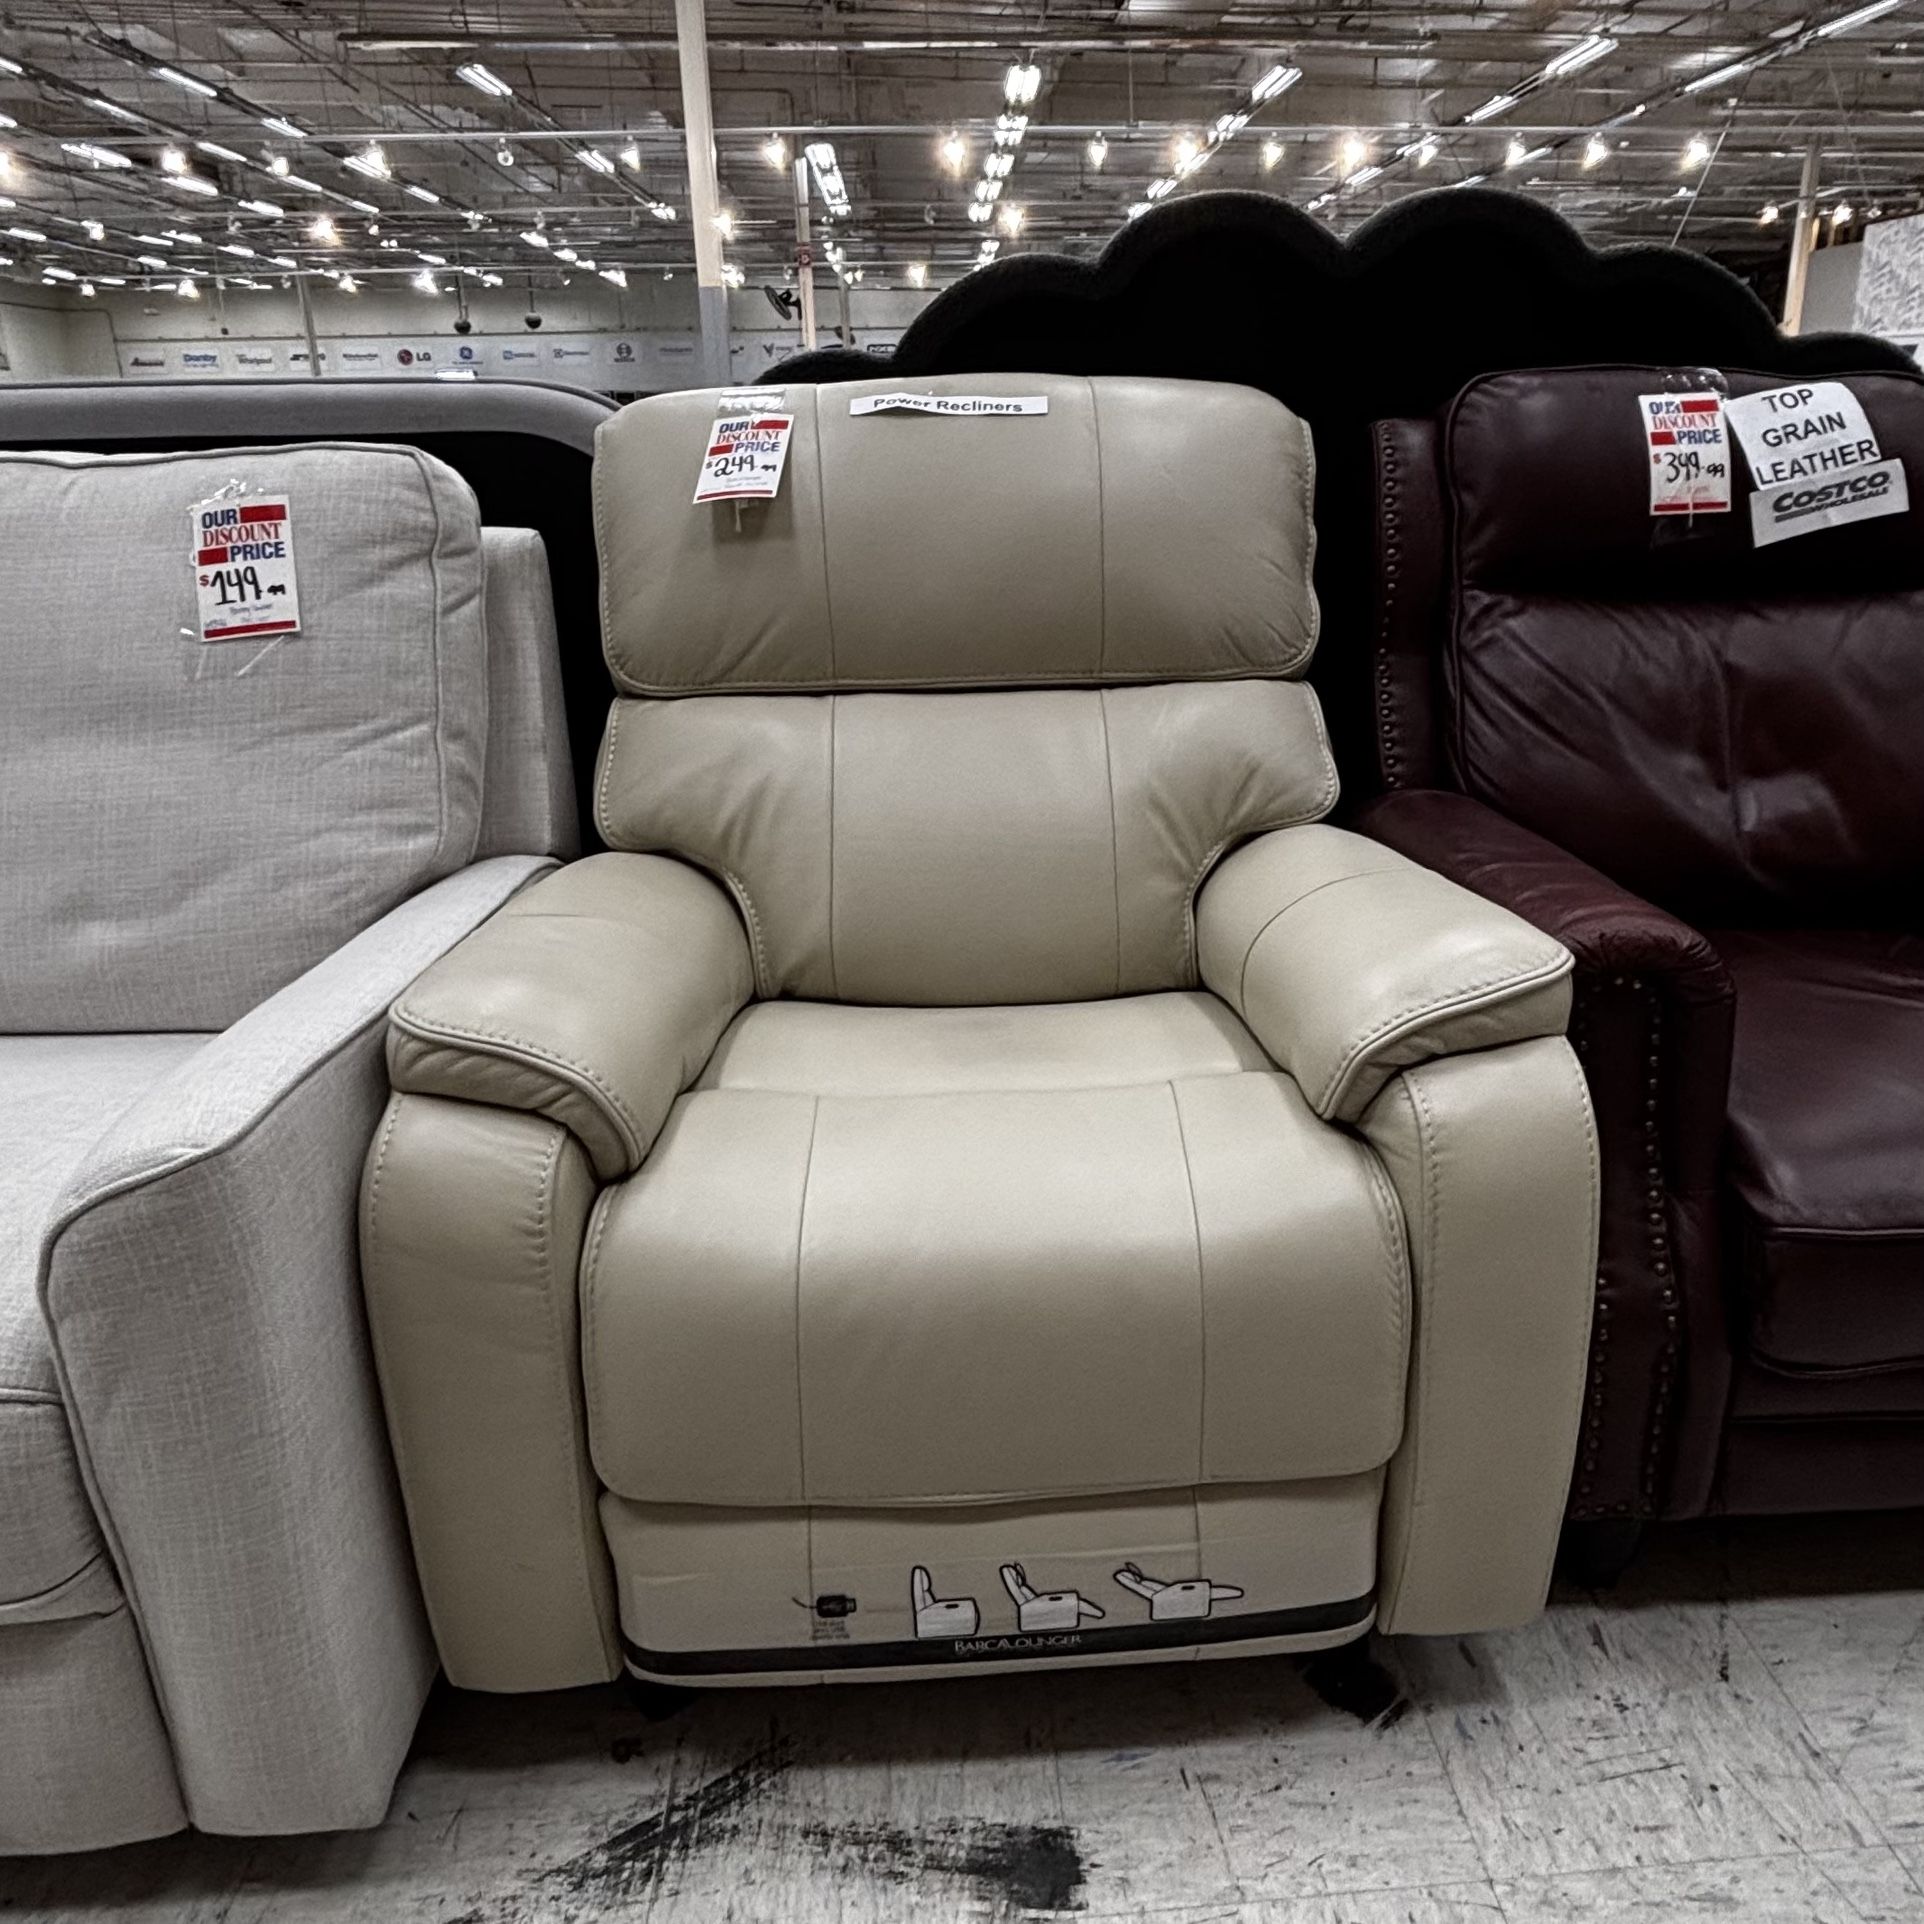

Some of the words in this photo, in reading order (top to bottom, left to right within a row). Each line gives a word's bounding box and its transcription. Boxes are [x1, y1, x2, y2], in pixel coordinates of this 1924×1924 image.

[182, 354, 218, 363] Danby
[416, 352, 432, 362] LG
[873, 397, 931, 408] Power
[936, 400, 1023, 413] Recliners
[1762, 388, 1814, 413] TOP
[719, 420, 749, 434] OUR
[1651, 412, 1717, 430] DISCOUNT
[1762, 411, 1848, 448] GRAIN
[716, 430, 782, 445] DISCOUNT
[1676, 428, 1722, 445] PRICE
[734, 440, 781, 453] PRICE
[1755, 438, 1880, 486] LEATHER
[1773, 471, 1890, 513] COSTCO
[1810, 486, 1889, 512] WHOLESALE
[201, 508, 239, 529] OUR
[202, 522, 282, 548] DISCOUNT
[230, 541, 286, 563] PRICE
